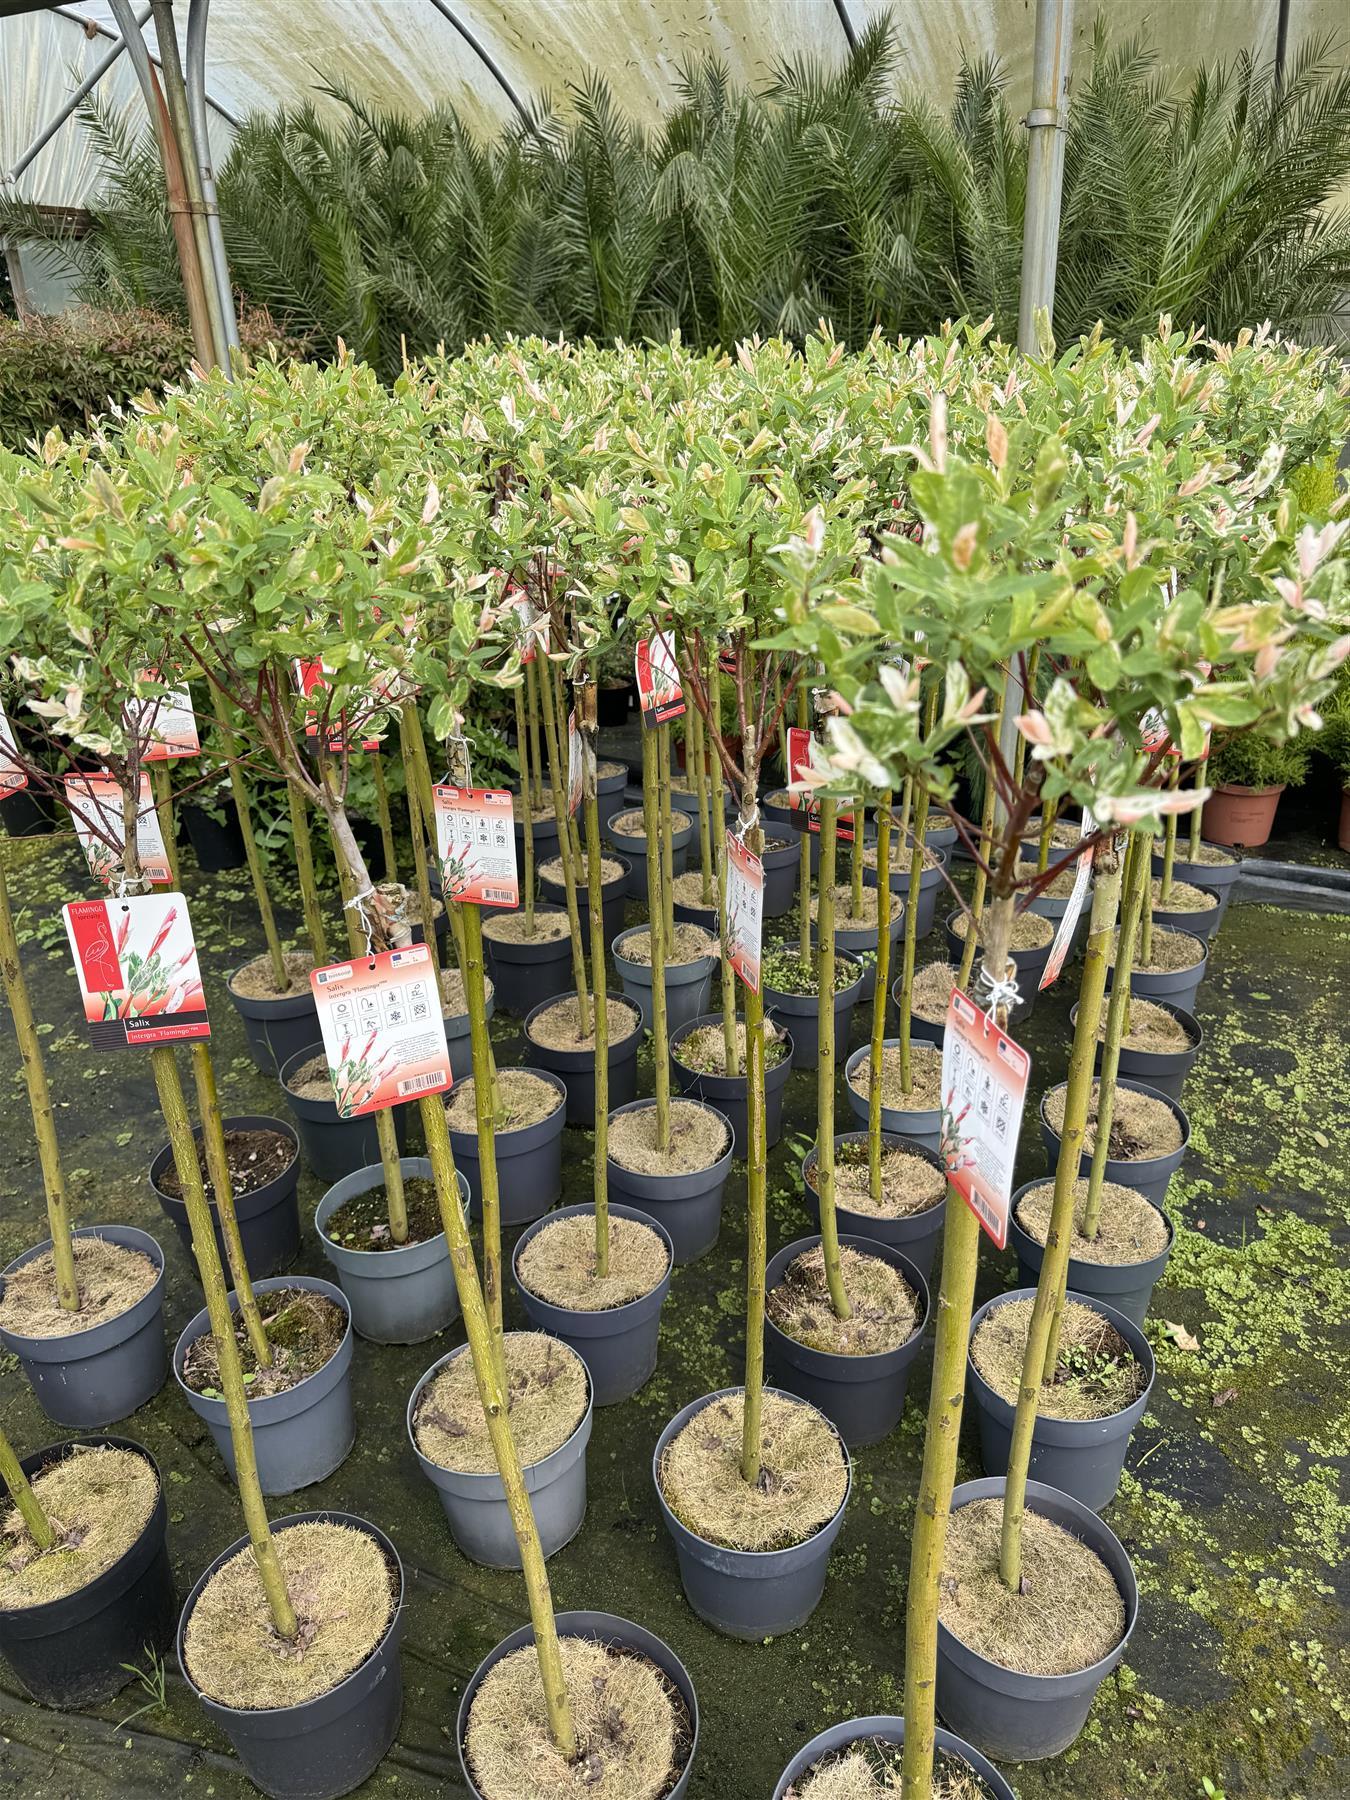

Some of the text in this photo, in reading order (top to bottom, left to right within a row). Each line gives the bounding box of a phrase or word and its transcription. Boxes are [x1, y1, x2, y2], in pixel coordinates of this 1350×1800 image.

[71, 905, 104, 914] FLAMINGO
[326, 984, 344, 992] Salix
[128, 1019, 150, 1028] Salix
